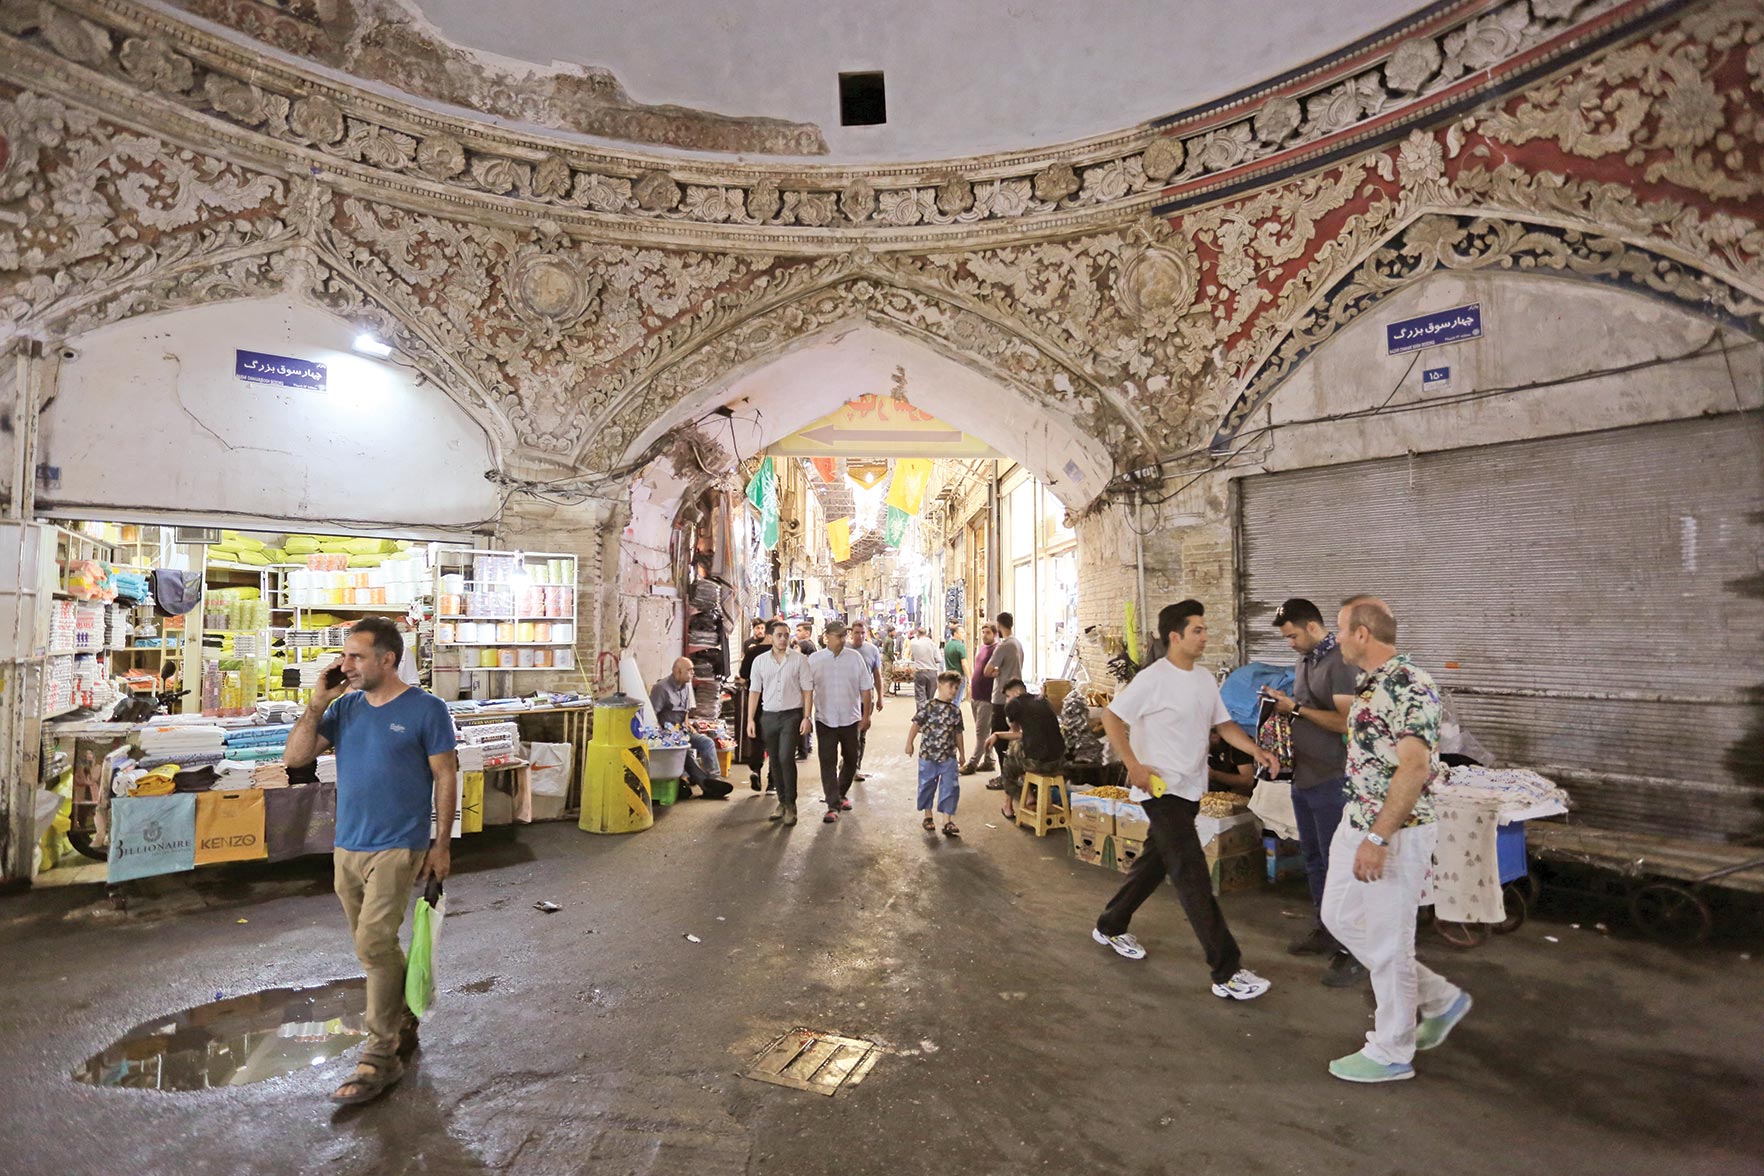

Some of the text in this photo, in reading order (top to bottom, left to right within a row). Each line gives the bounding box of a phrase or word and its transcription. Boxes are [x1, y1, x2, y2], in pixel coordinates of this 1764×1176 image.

[1393, 328, 1424, 340] بزرگ
[243, 360, 276, 374] بزرگ
[1429, 371, 1443, 381] ۱۵۰
[201, 833, 256, 850] KENZO
